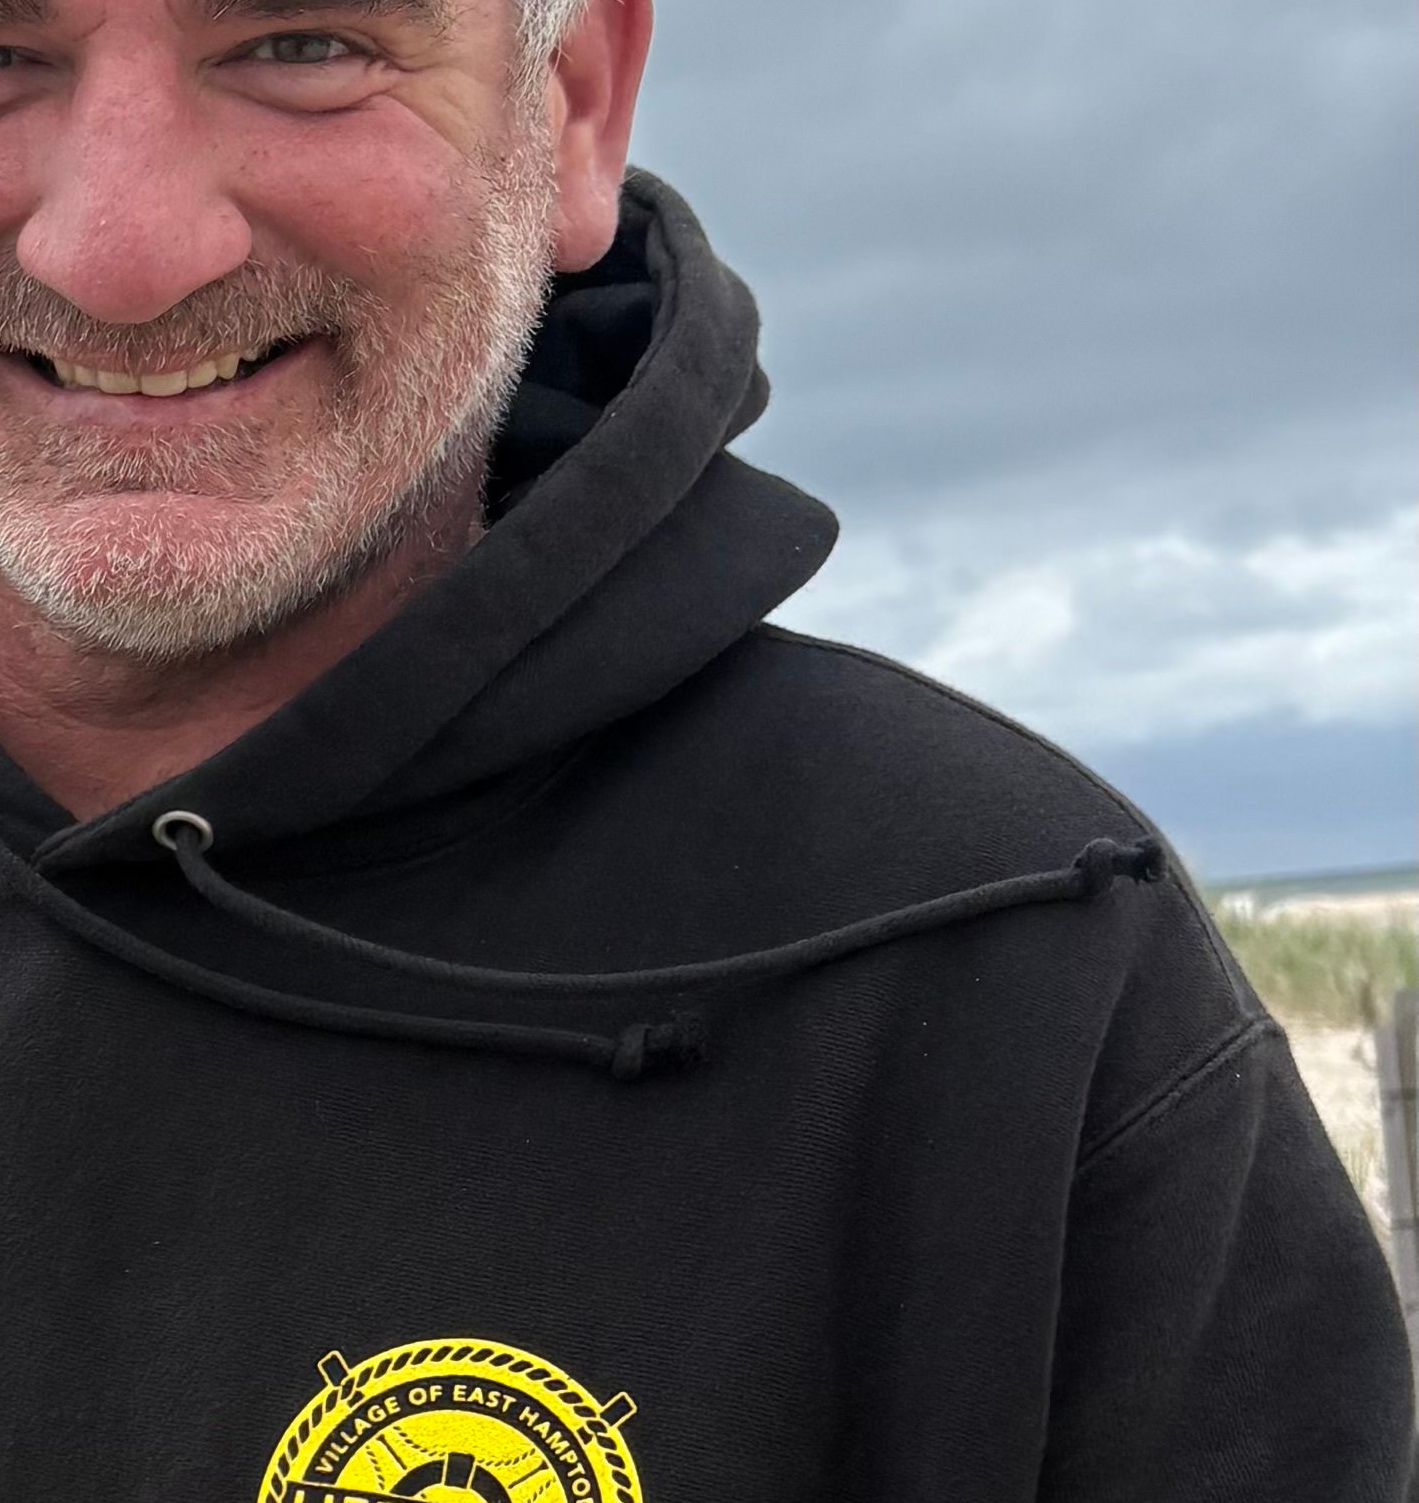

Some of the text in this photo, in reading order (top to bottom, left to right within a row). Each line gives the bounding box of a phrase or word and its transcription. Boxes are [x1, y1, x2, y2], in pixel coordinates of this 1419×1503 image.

[315, 1396, 401, 1473] VILLAGE
[408, 1385, 443, 1406] OF
[453, 1384, 517, 1413] EAST
